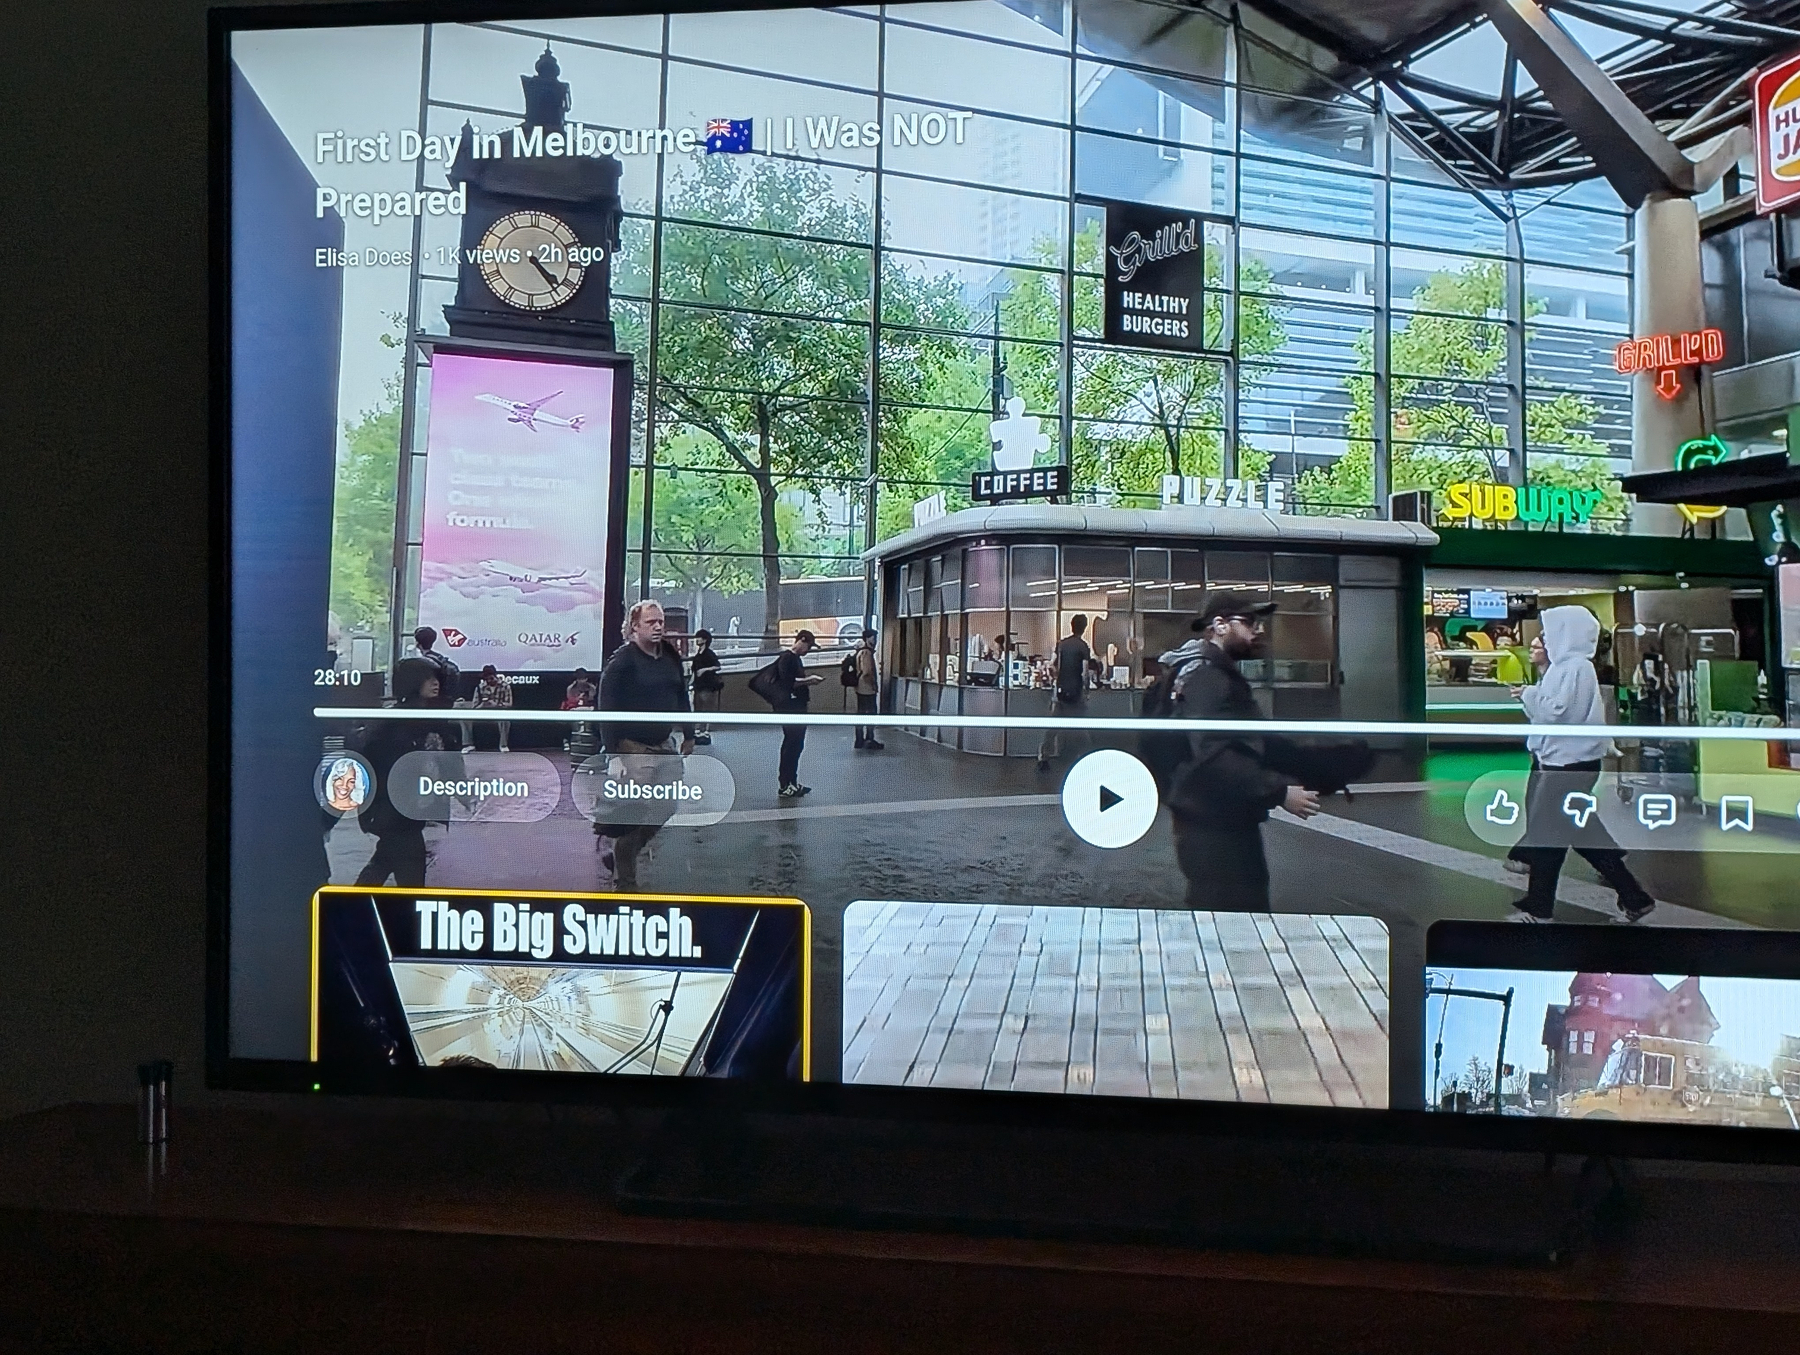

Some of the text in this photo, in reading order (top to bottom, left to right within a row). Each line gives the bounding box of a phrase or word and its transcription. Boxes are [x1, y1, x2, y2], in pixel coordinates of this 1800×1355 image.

[316, 130, 391, 164] First
[400, 129, 462, 168] Day
[472, 126, 502, 160] in
[512, 123, 696, 158] Melbourne
[785, 116, 794, 149] I
[805, 115, 882, 149] Was
[892, 110, 973, 146] NOT
[316, 181, 468, 225] Prepared
[315, 244, 605, 268] Elisa Does 1K views 2h ago
[1109, 218, 1198, 282] Grill'd
[1122, 290, 1190, 315] HEALTHY
[1122, 314, 1190, 338] BURGERS
[1615, 328, 1724, 374] GRILL'D
[980, 470, 1058, 496] COFFEE
[1162, 474, 1285, 511] PUZZLE
[1444, 483, 1603, 525] SUBWAY
[518, 632, 562, 644] QATAR
[314, 668, 361, 686] 28:10
[419, 776, 703, 801] Description Subscribe
[415, 900, 702, 959] The Big Switch.
